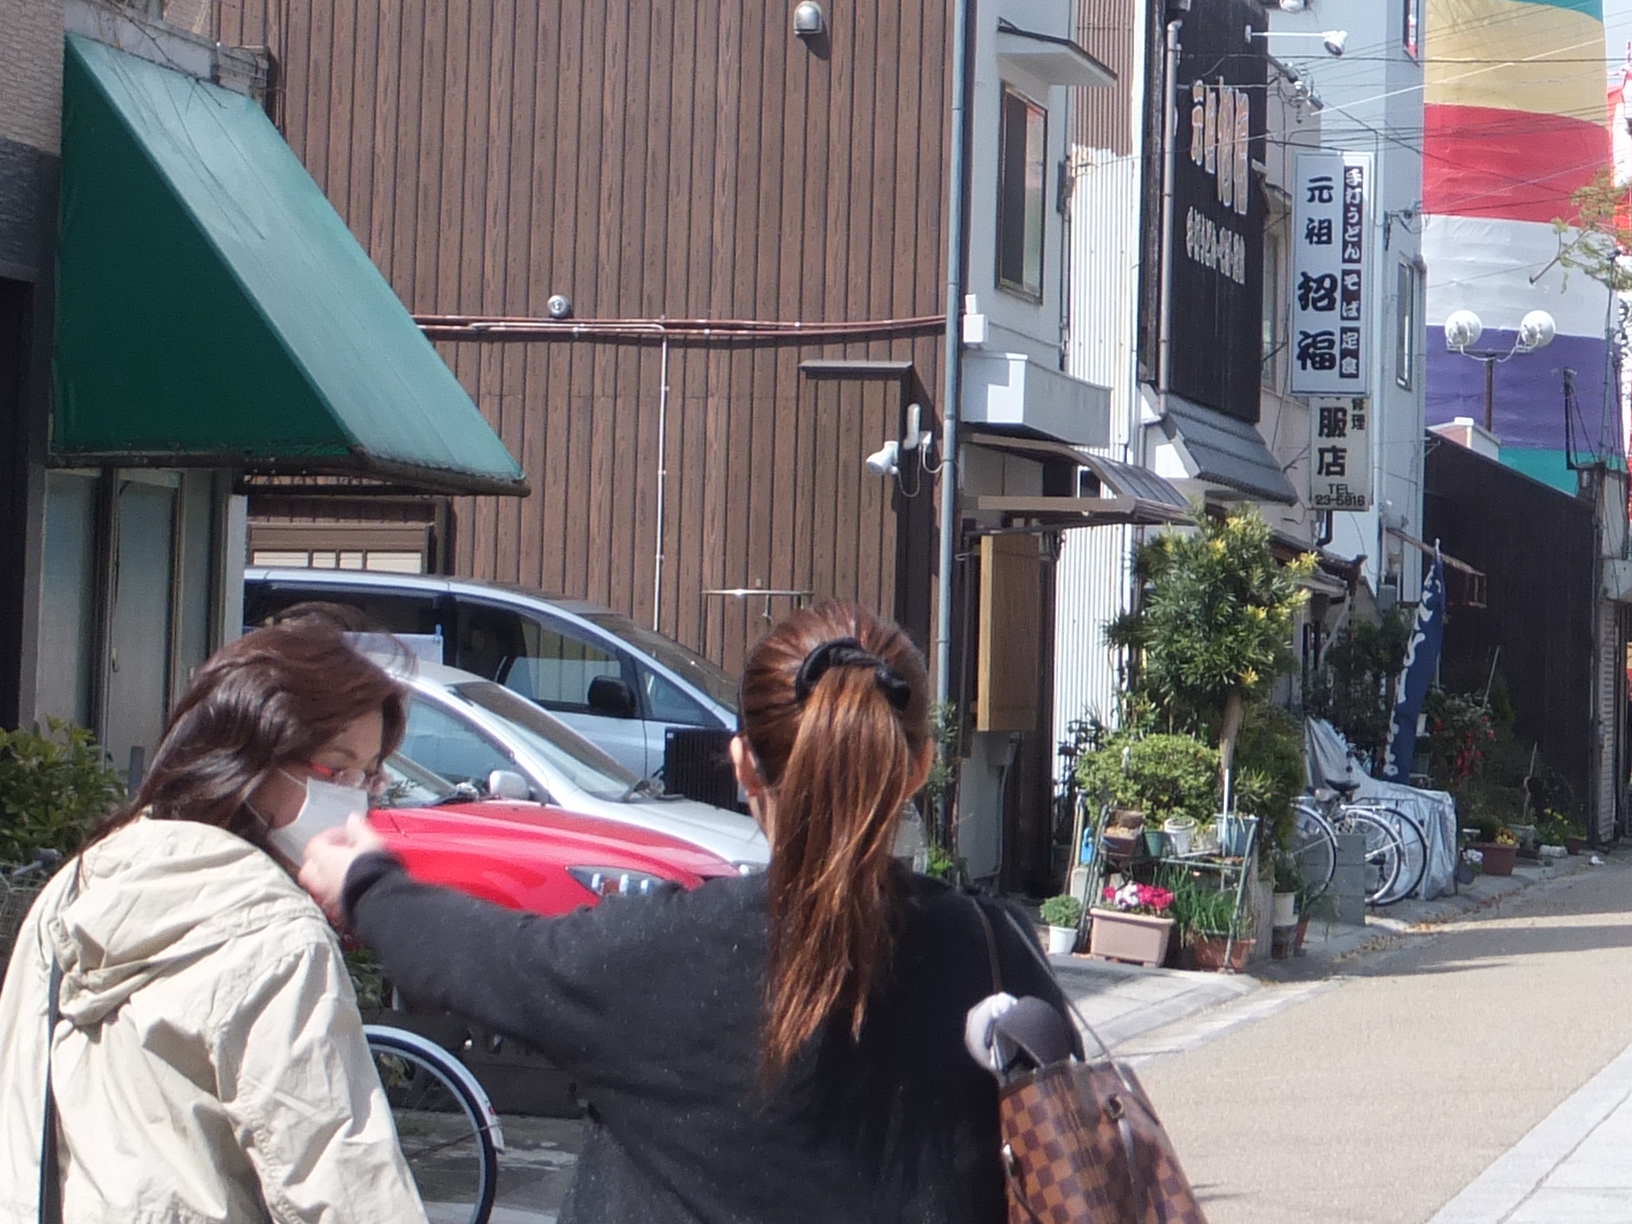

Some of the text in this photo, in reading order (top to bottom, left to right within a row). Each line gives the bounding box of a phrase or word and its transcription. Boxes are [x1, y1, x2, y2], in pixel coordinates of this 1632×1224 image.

[1343, 167, 1363, 260] 手打うどん
[1341, 273, 1360, 317] そば
[1317, 395, 1347, 476] 服店
[1328, 483, 1353, 496] TEL
